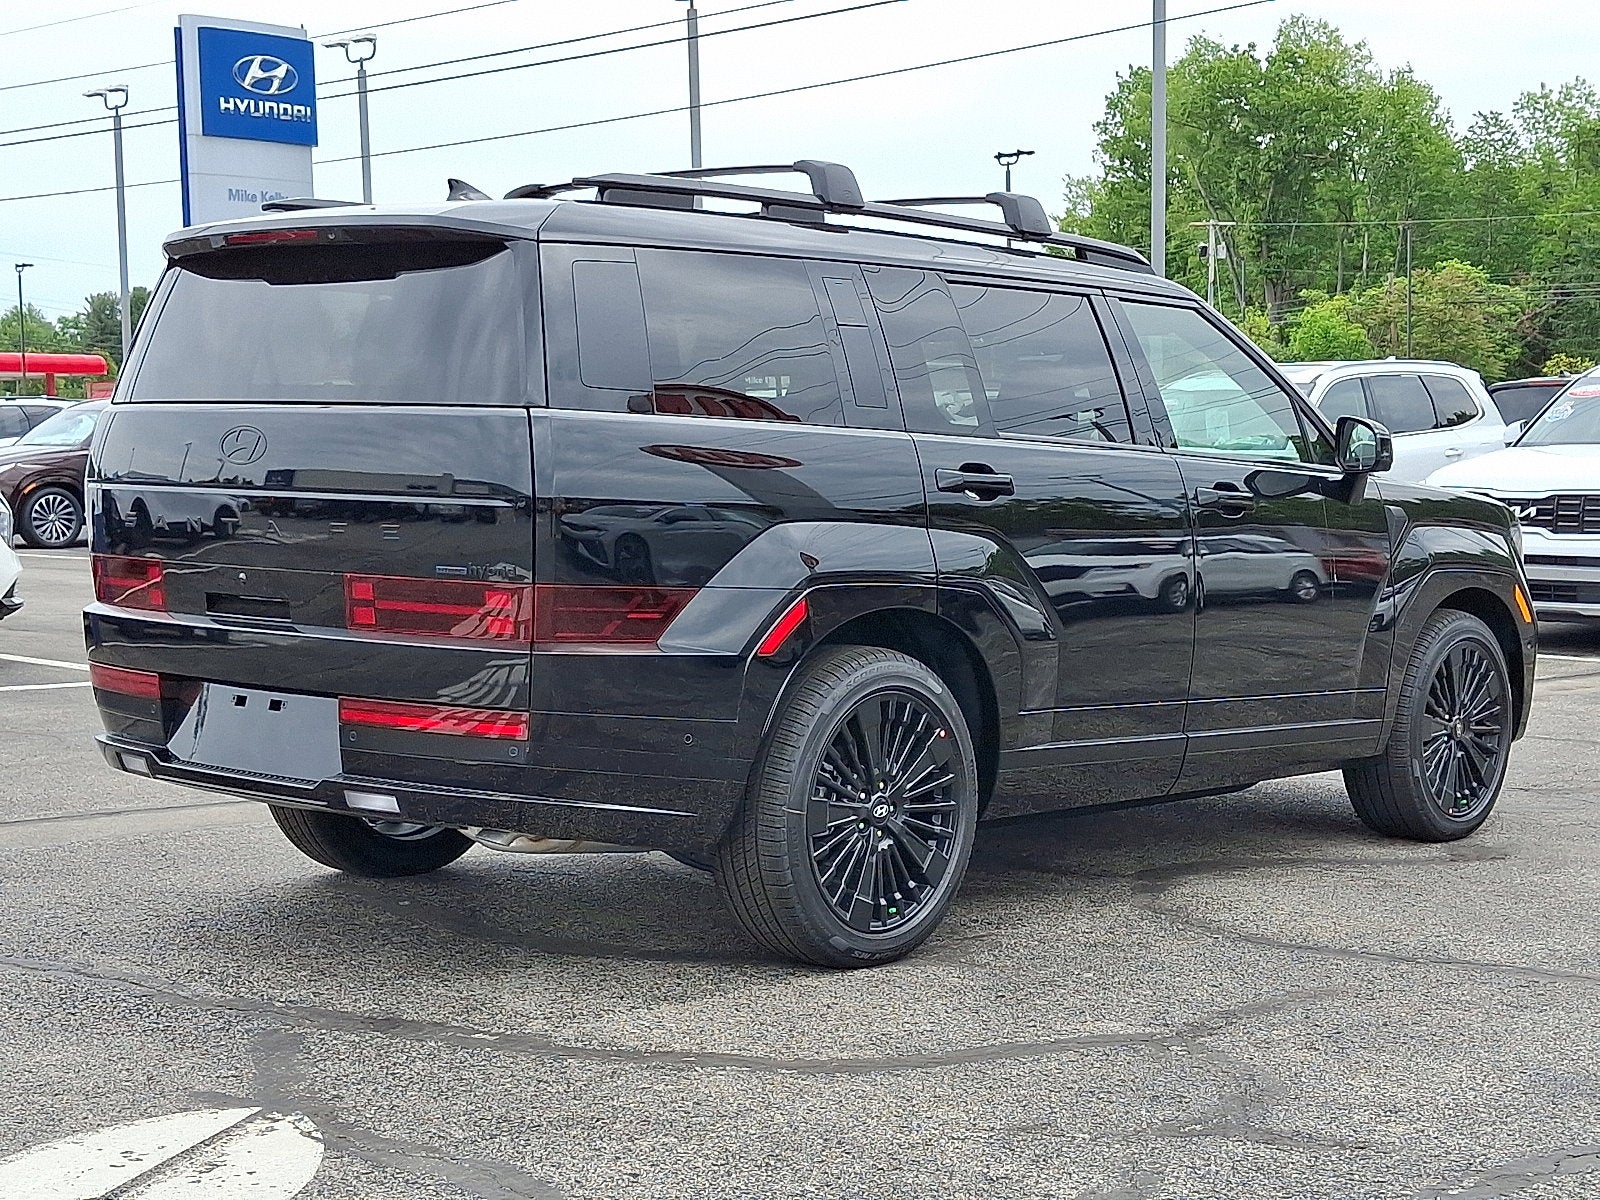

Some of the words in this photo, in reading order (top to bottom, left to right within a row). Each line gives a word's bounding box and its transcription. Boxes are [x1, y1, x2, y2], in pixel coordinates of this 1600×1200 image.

[219, 96, 311, 123] HYUNDAI
[227, 188, 258, 203] Mike
[124, 510, 283, 537] SANTA
[329, 521, 400, 541] FE
